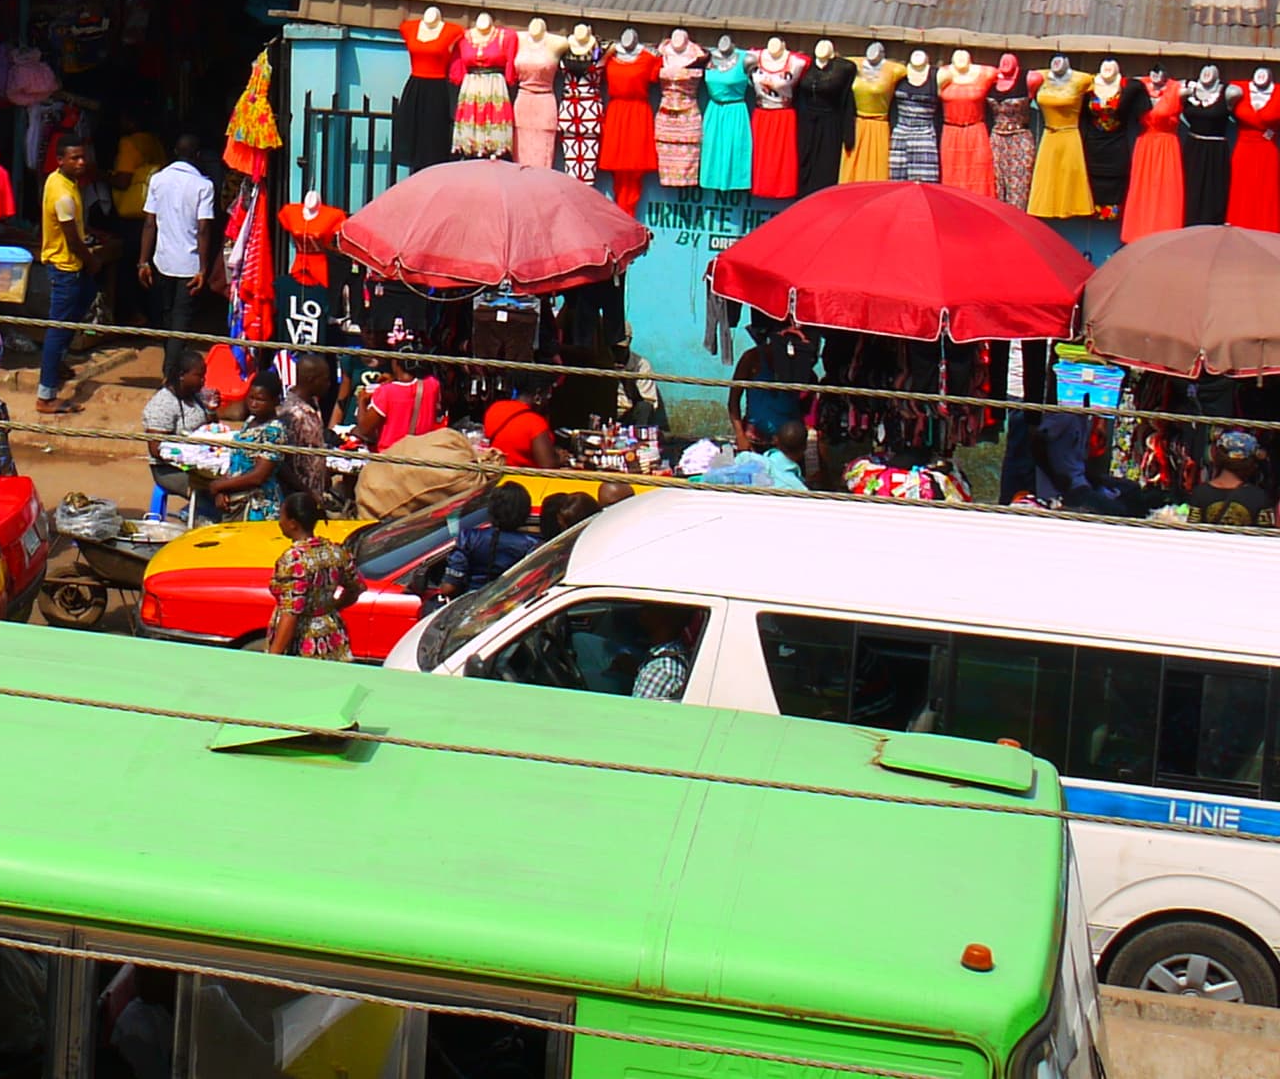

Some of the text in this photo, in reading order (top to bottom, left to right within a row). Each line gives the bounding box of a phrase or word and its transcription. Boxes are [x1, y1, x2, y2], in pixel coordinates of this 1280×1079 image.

[647, 201, 780, 234] URINATE HE
[676, 230, 701, 248] BY
[1169, 800, 1240, 830] LINE
